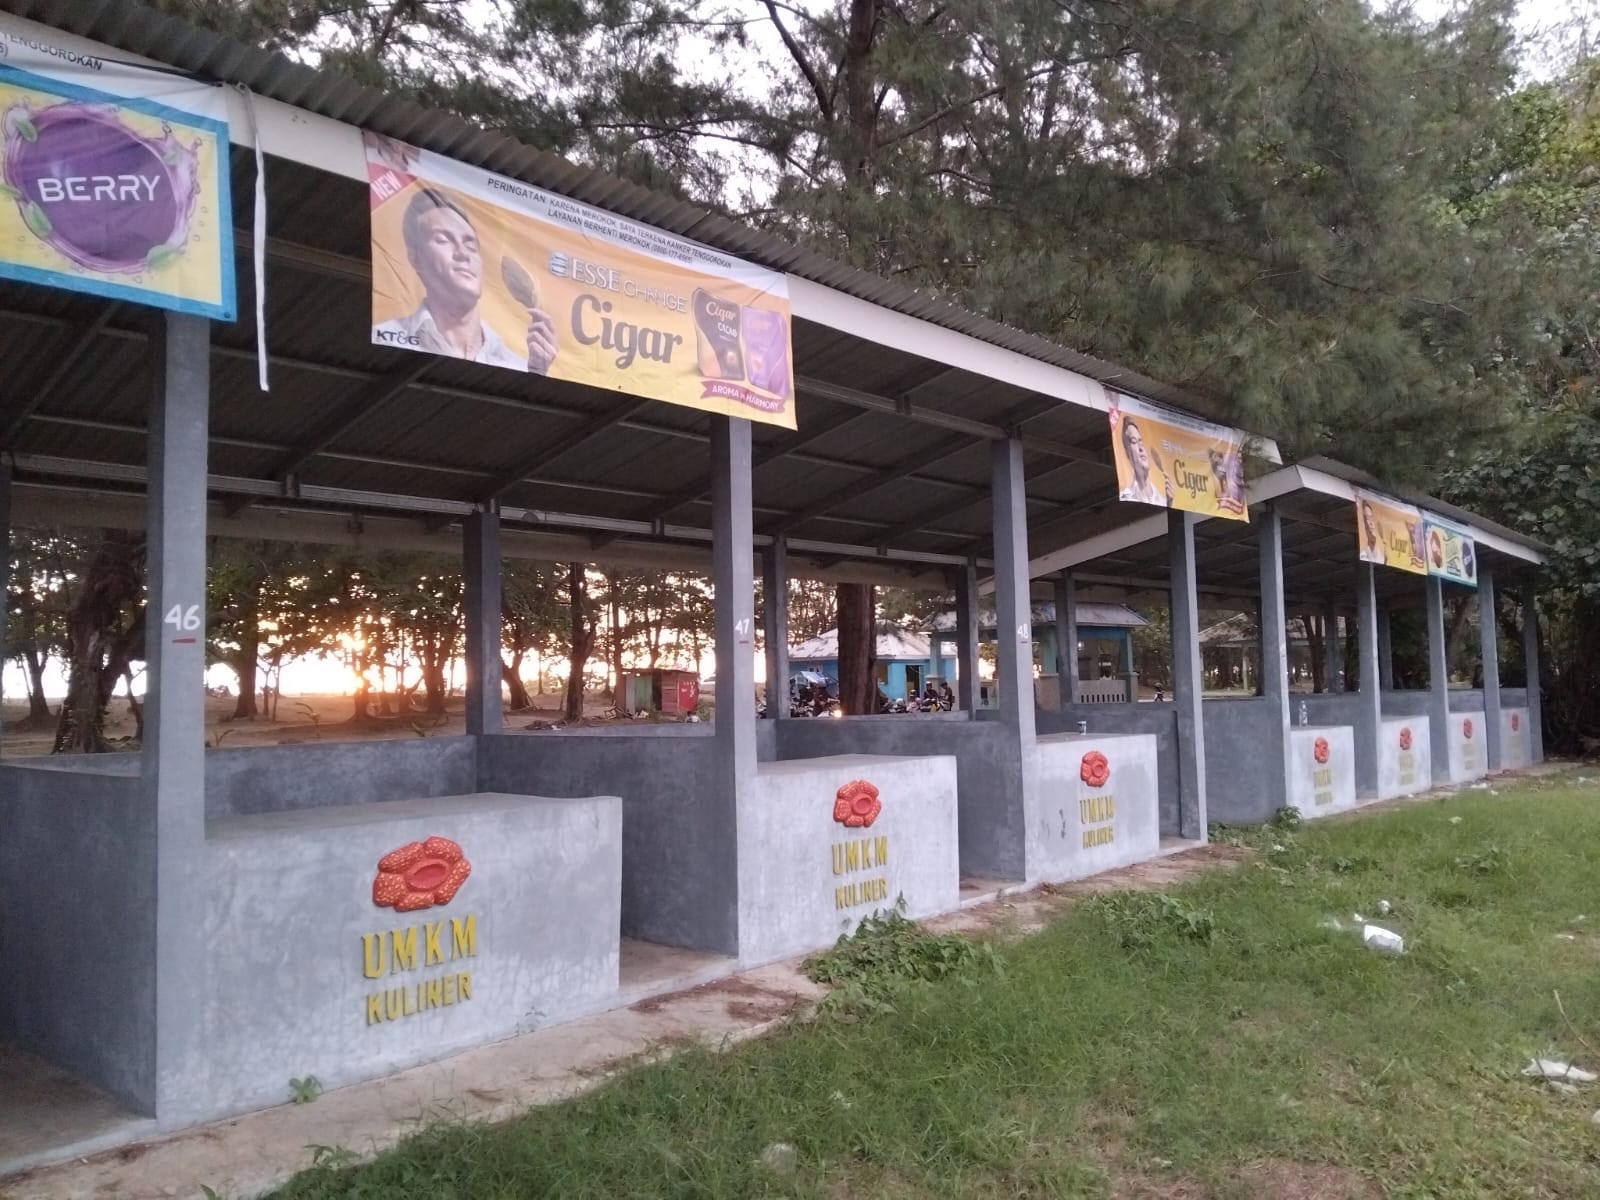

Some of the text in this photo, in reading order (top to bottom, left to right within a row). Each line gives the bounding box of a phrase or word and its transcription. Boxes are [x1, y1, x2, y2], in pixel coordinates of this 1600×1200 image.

[37, 174, 160, 203] BERRY
[371, 169, 402, 201] NEW
[547, 207, 583, 226] LAYANAN
[584, 220, 618, 239] BERHENTI
[618, 231, 650, 250] MEROKOK
[550, 197, 580, 214] KARENA
[619, 222, 636, 235] SAYA
[638, 229, 666, 246] TERKENA
[666, 238, 691, 254] KANKER
[692, 247, 732, 269] TENGGOROKAN
[571, 257, 688, 314] ESSE CHANGE
[705, 301, 737, 322] Cigar
[376, 329, 421, 346] KT&G
[571, 293, 683, 370] Cigar
[712, 384, 740, 399] AROMA
[745, 392, 779, 411] HARMONY
[1173, 458, 1209, 500] Cigar
[164, 603, 201, 631] 46
[735, 617, 751, 636] 47
[1017, 623, 1029, 639] 48
[1079, 795, 1115, 824] UMKM
[831, 835, 888, 876] UMKM
[834, 878, 888, 911] KULINER
[361, 912, 477, 980] UMKM
[366, 971, 474, 1027] KULINER
